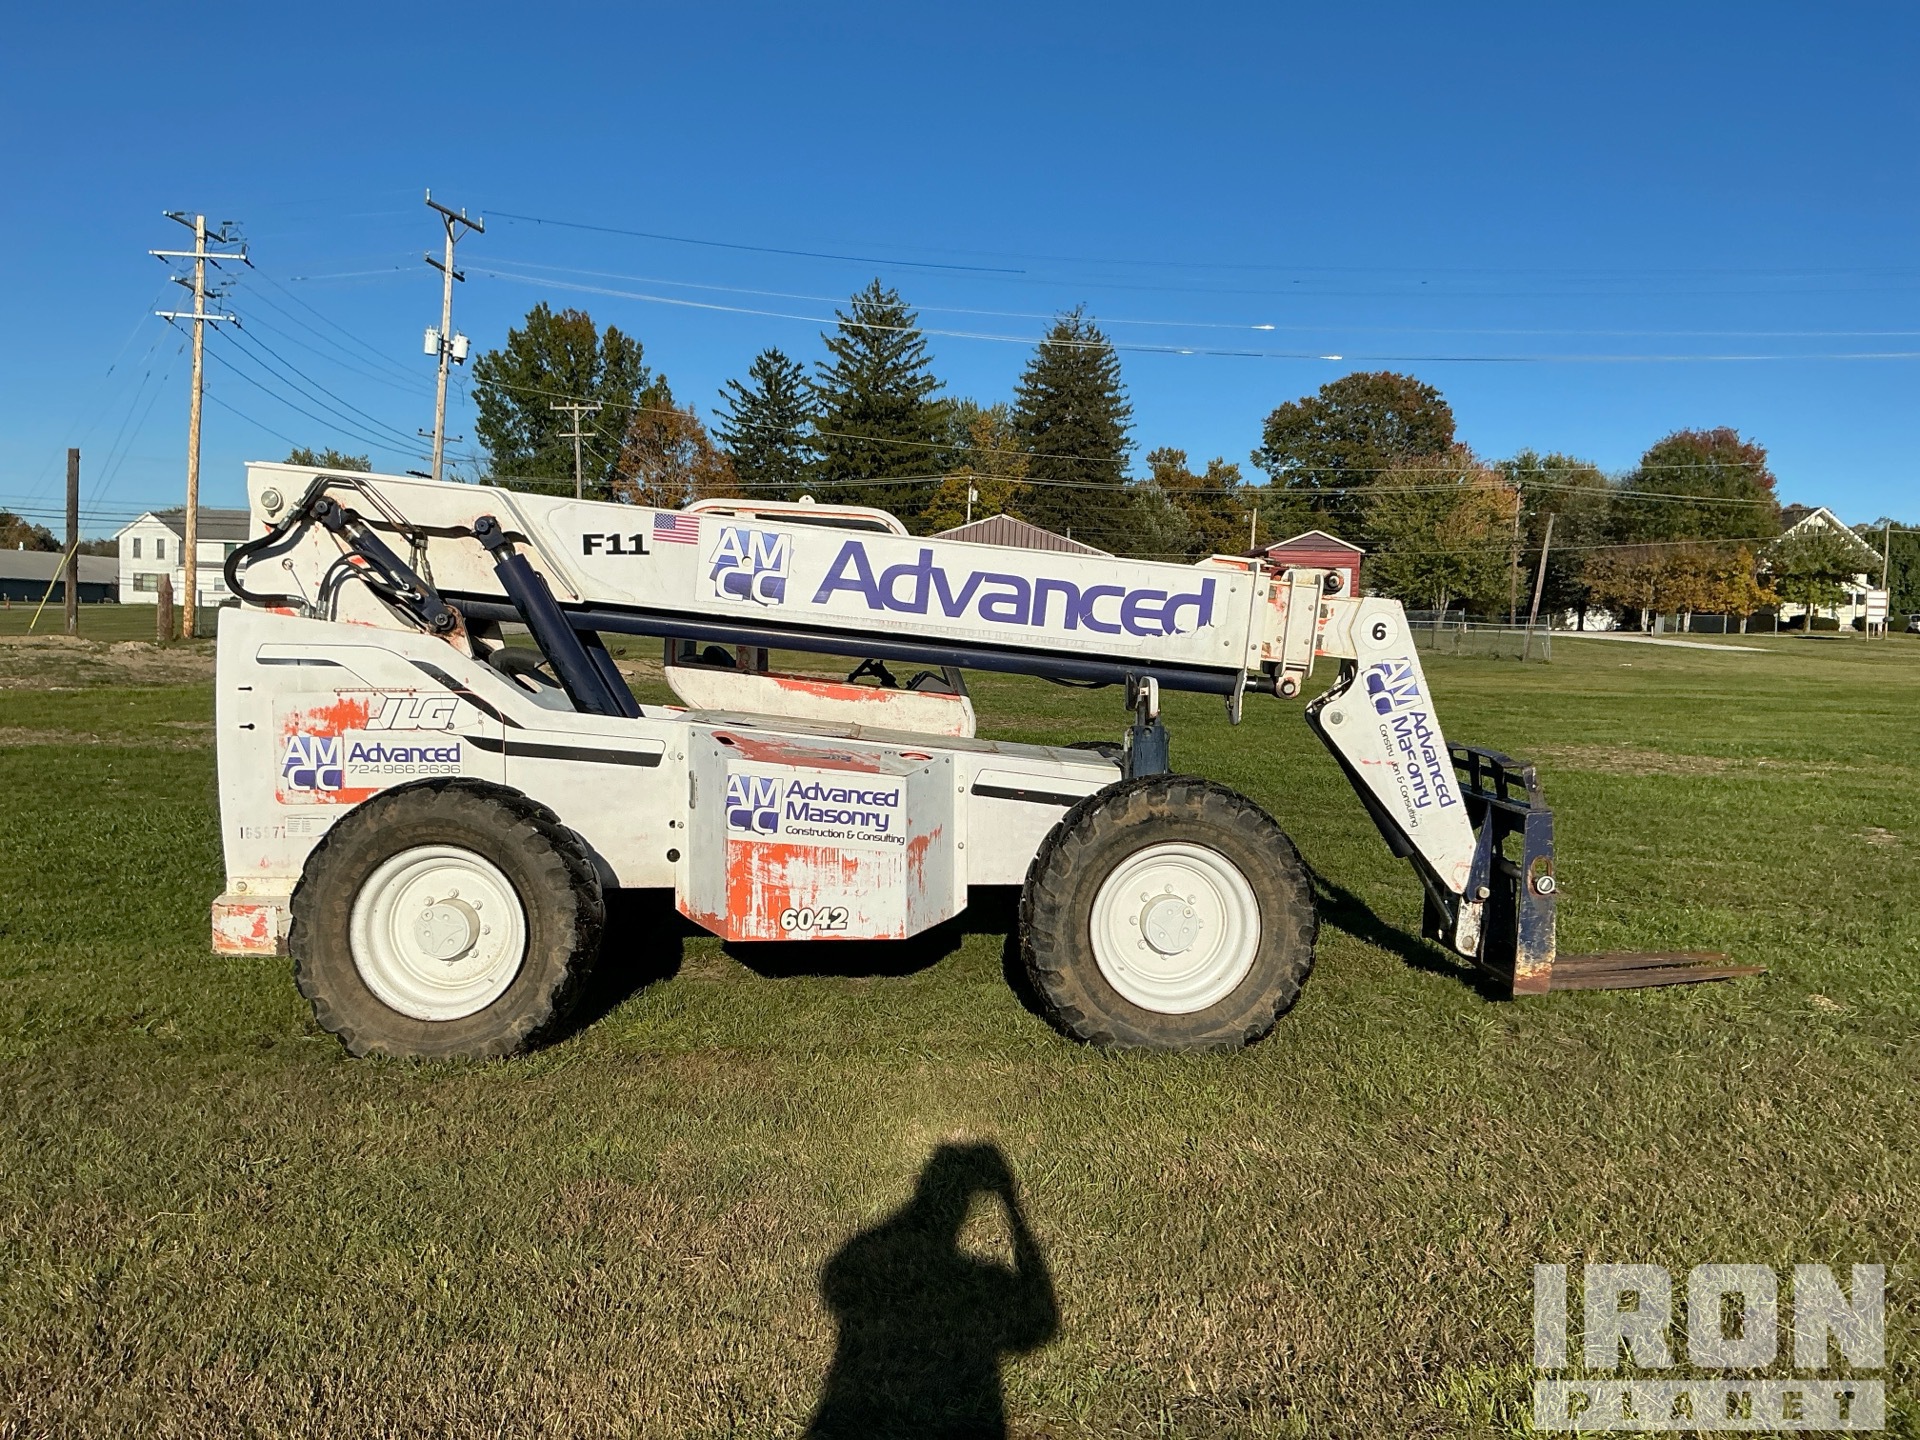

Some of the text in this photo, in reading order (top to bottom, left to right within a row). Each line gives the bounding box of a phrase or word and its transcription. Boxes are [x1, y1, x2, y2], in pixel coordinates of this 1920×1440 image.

[582, 533, 650, 556] F11
[709, 527, 792, 578] AM
[812, 540, 1216, 637] Advanced
[1372, 622, 1387, 640] 6
[364, 697, 459, 731] JLG
[281, 735, 342, 770] AM
[348, 742, 461, 763] Advanced
[1410, 711, 1457, 808] Advanced
[348, 764, 461, 774] 724.966.2636
[1379, 723, 1419, 828] Construion & Consulting
[725, 773, 784, 813] AM
[785, 780, 899, 807] Advanced
[786, 801, 890, 832] Masonry
[785, 825, 905, 845] Construction & Consulting
[780, 906, 849, 931] 6042
